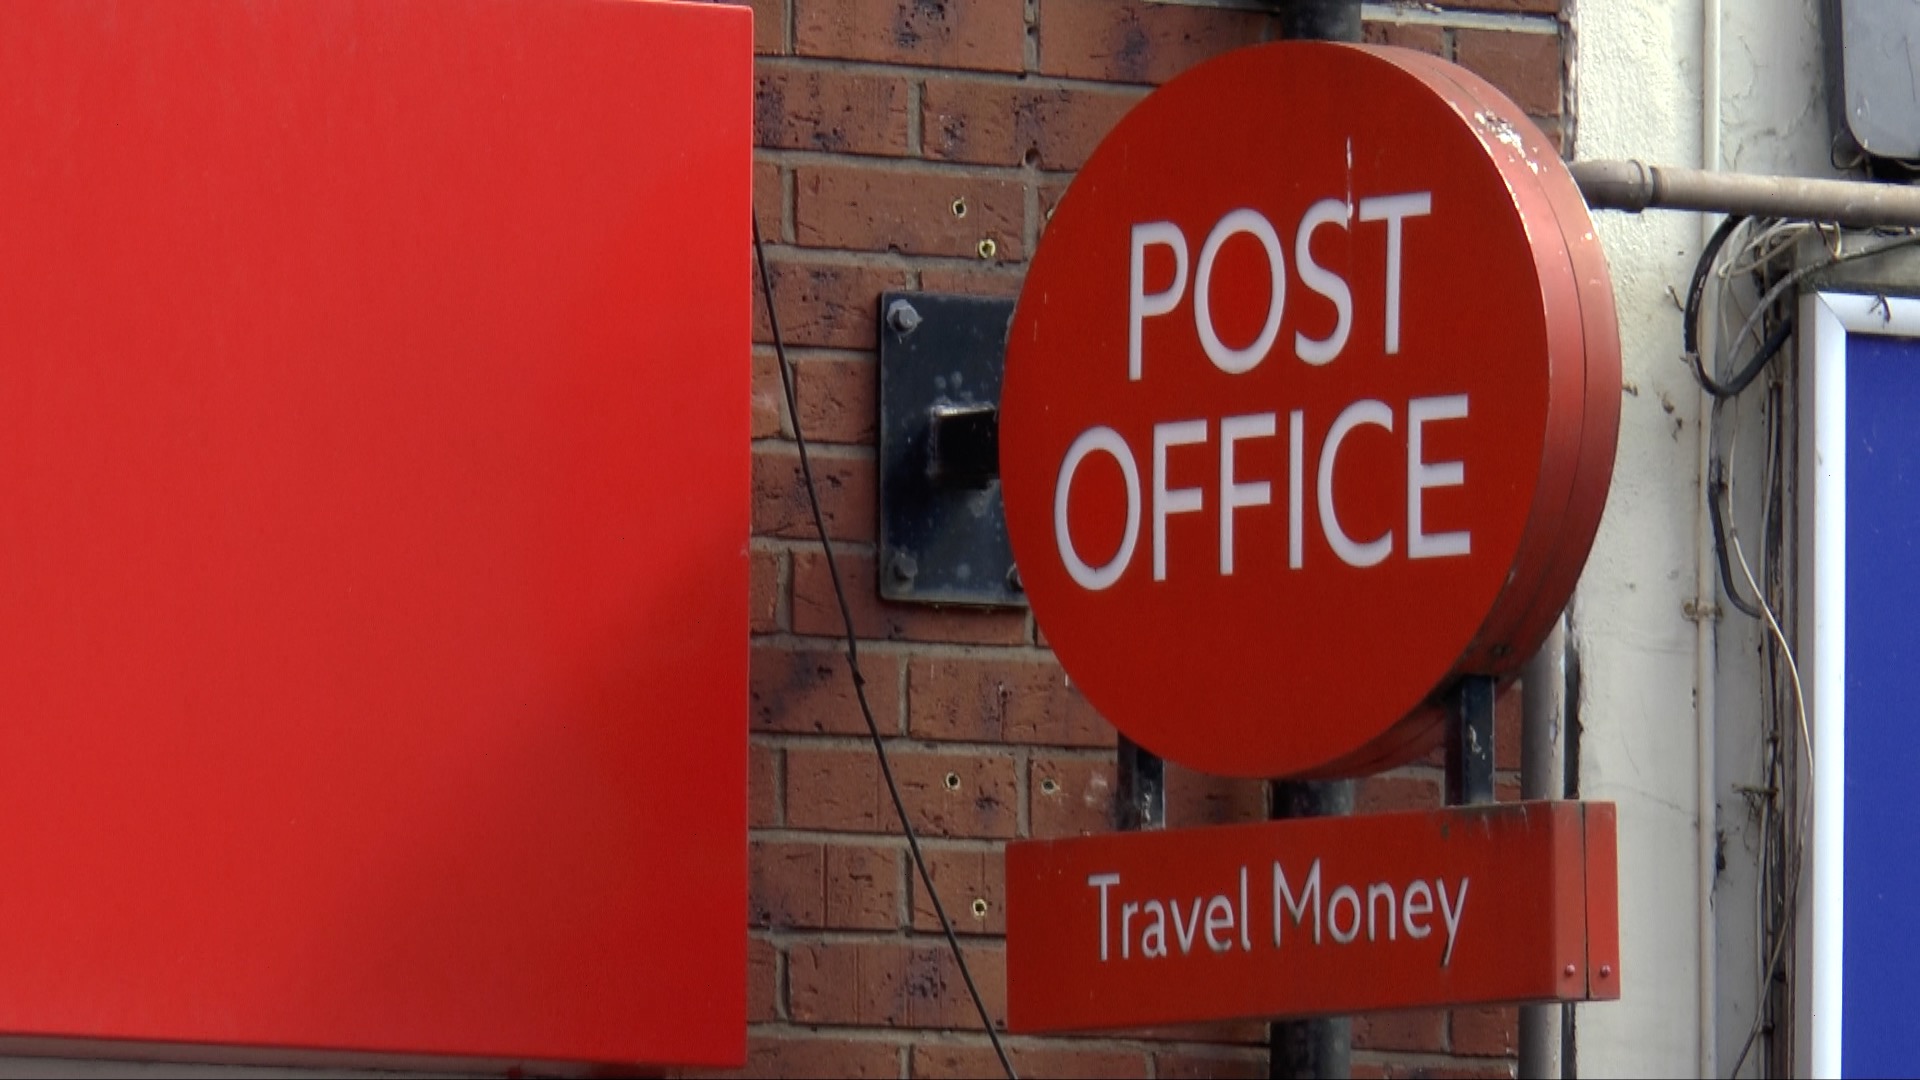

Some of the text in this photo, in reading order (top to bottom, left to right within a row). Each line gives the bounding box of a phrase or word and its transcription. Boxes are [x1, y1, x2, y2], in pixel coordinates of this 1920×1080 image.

[1128, 192, 1432, 381] POST
[1054, 395, 1472, 591] OFFICE
[1087, 858, 1469, 966] Travel Money
